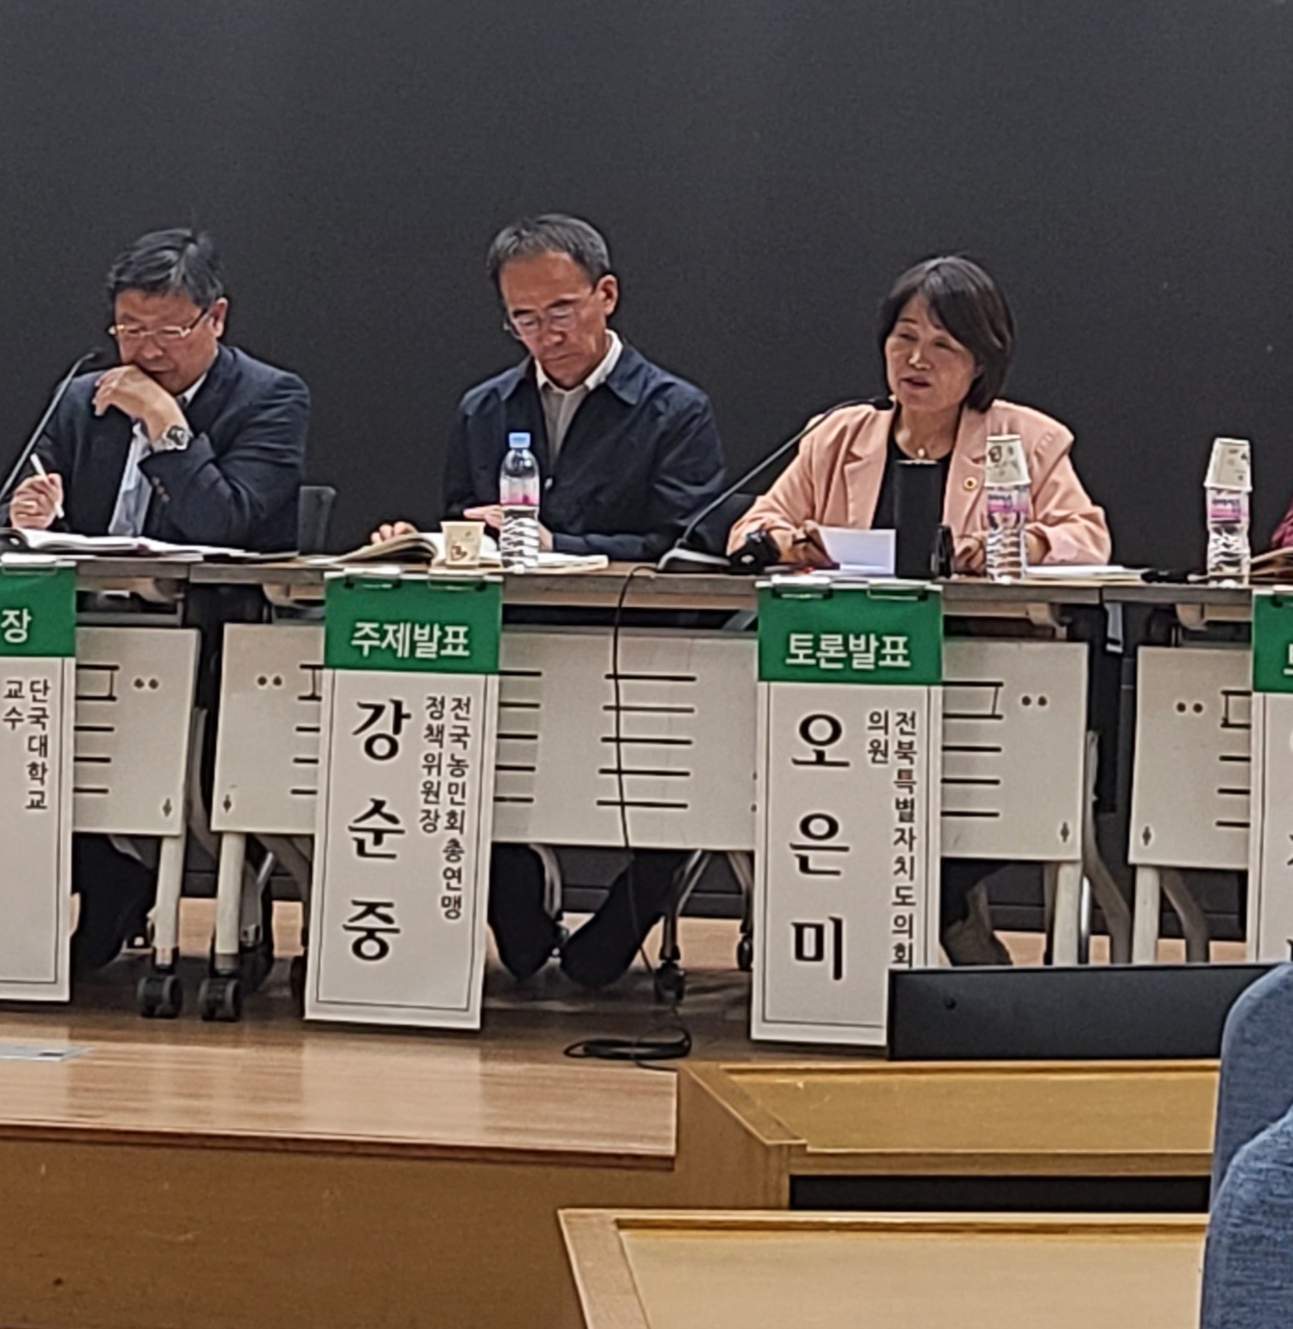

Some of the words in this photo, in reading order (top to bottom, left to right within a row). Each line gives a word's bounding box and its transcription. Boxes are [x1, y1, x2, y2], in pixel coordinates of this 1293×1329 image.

[349, 621, 471, 659] 주제발표
[785, 633, 911, 670] 토론발표
[2, 679, 26, 732] 교수
[25, 679, 51, 811] 단국대학교
[418, 695, 446, 834] 정책위원장
[867, 709, 890, 765] 의원
[441, 696, 472, 921] 전국농민회총연맹
